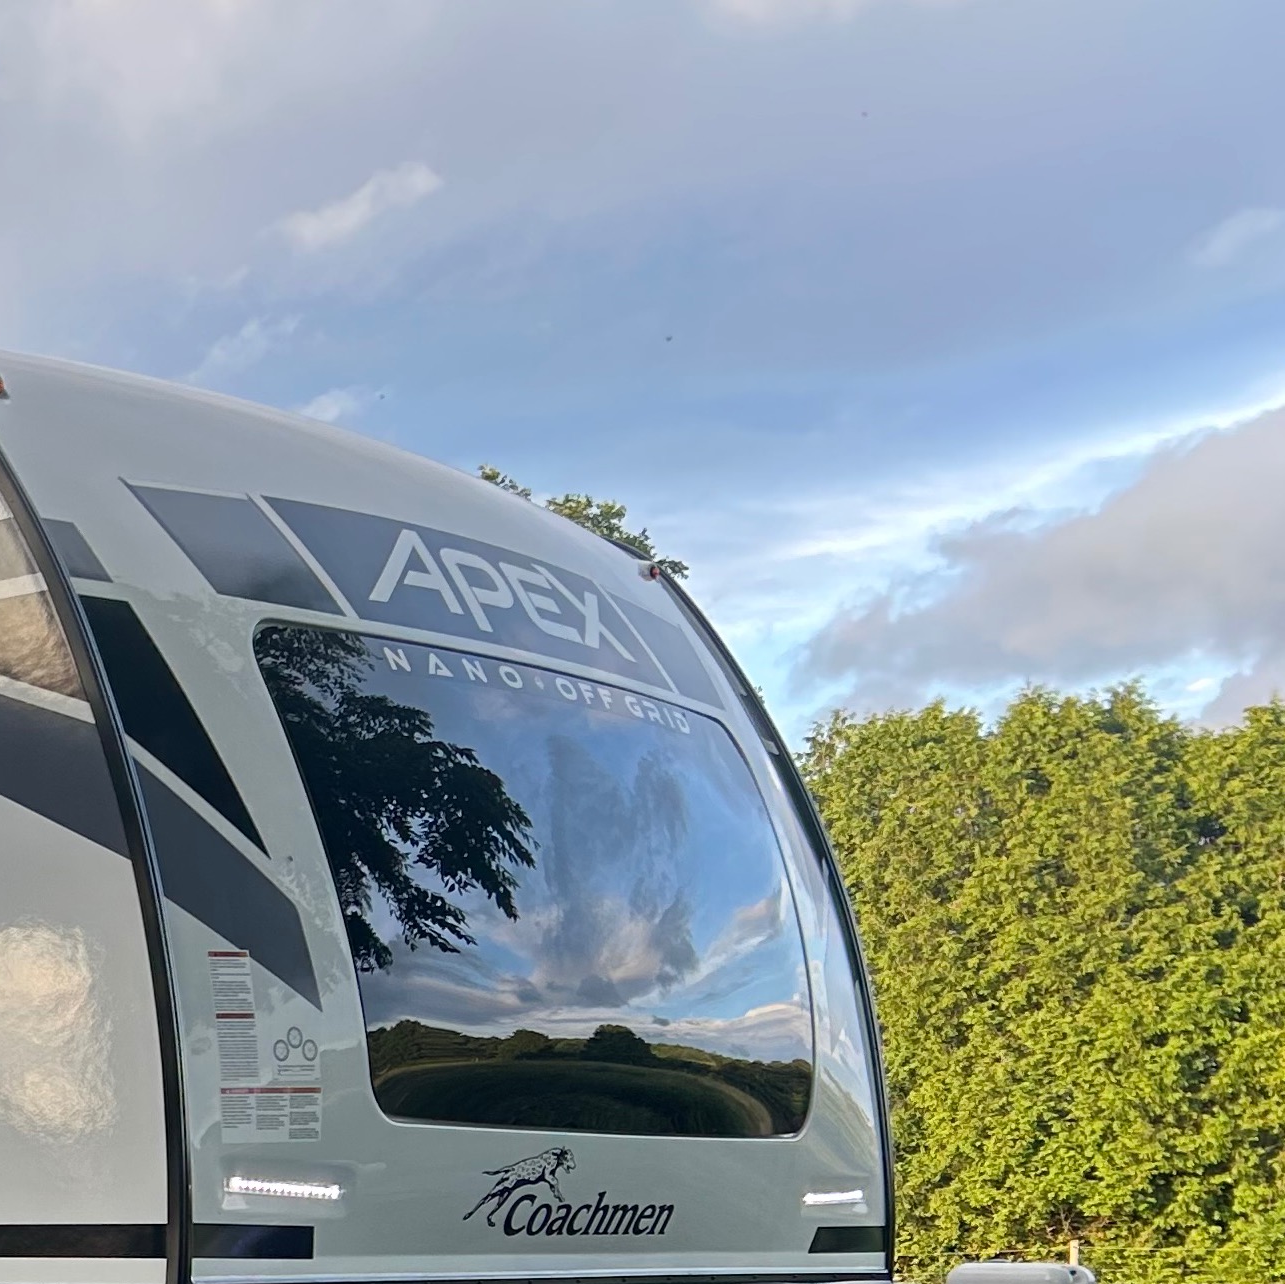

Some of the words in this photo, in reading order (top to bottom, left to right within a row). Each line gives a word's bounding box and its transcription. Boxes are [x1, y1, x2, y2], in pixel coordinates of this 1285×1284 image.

[368, 529, 637, 663] APEX
[383, 647, 523, 689] NANO
[555, 677, 613, 709] OFF
[624, 696, 691, 735] GRID
[503, 1191, 675, 1236] Coachmen
